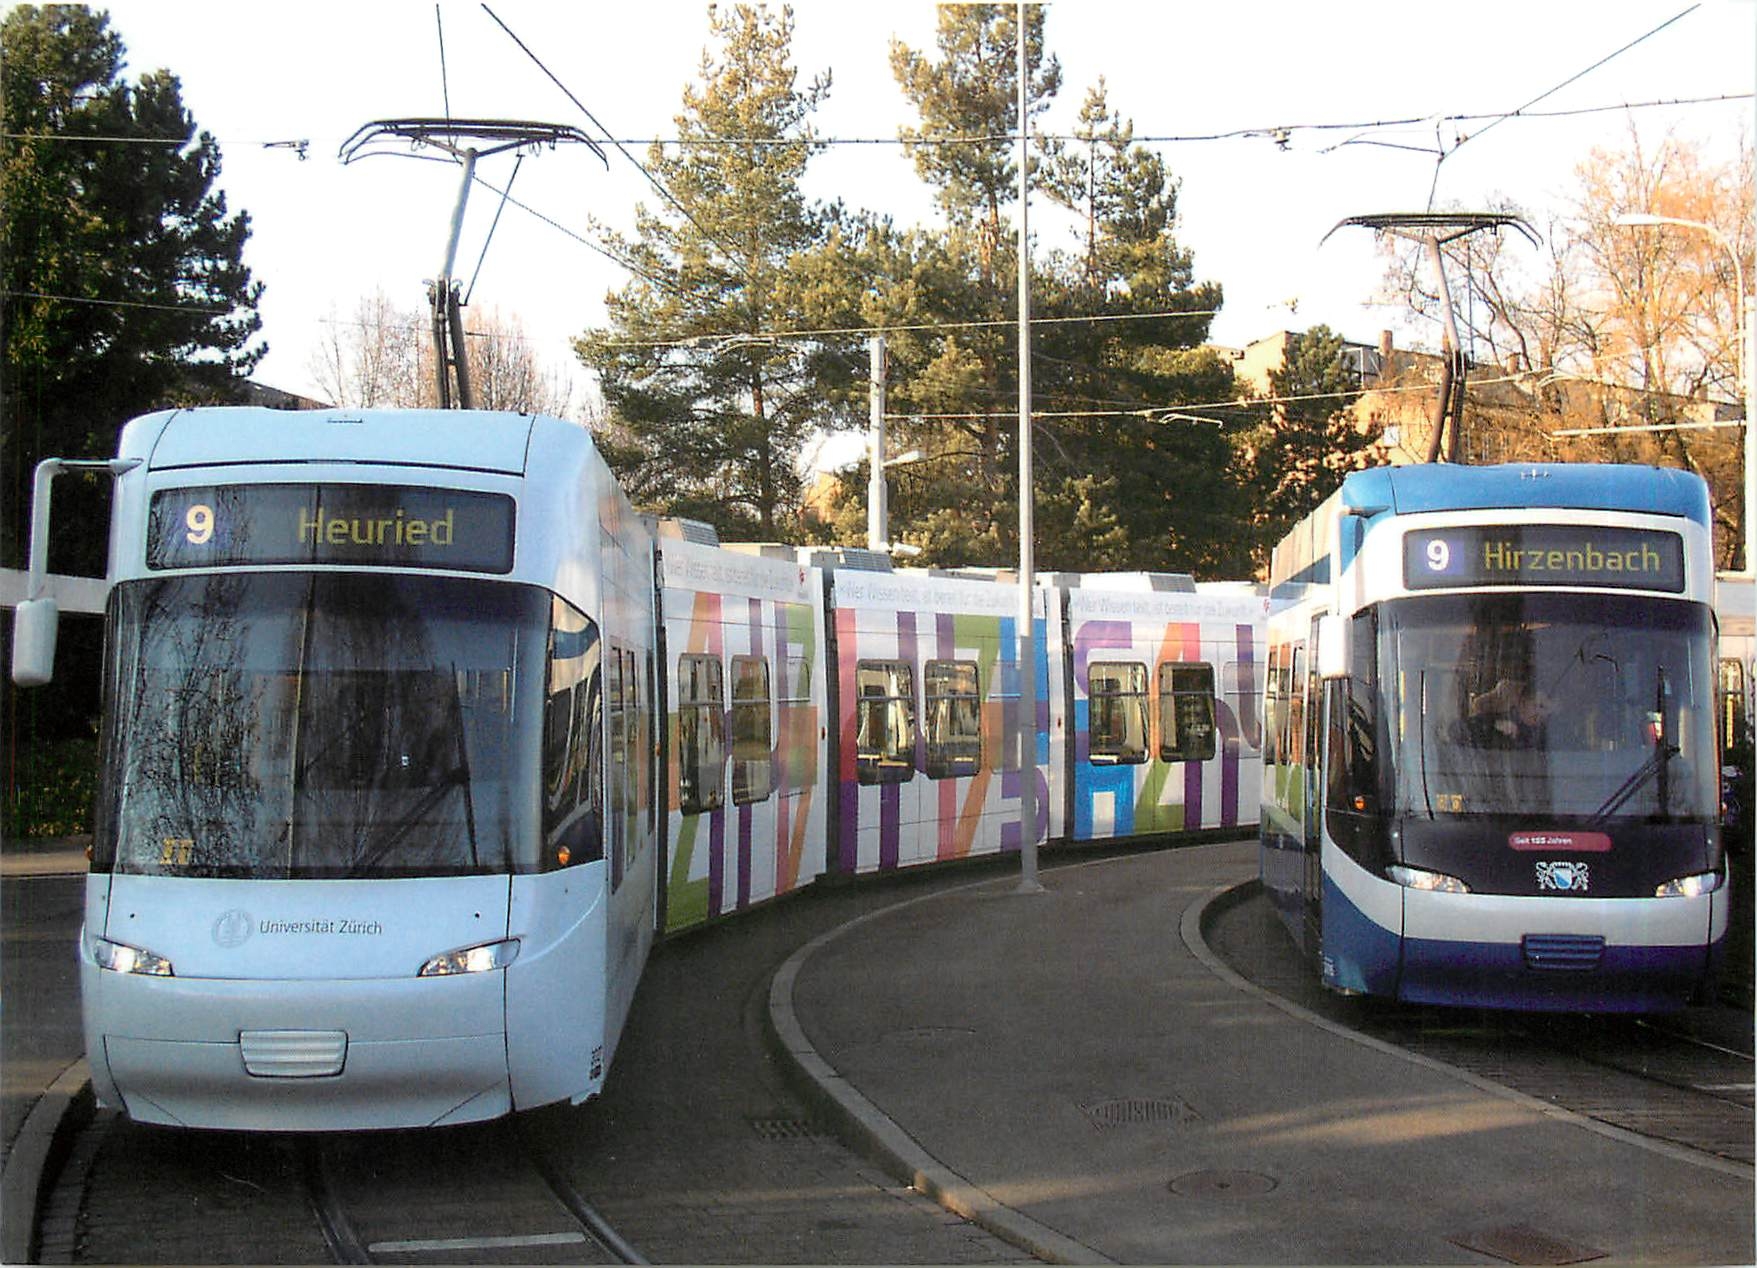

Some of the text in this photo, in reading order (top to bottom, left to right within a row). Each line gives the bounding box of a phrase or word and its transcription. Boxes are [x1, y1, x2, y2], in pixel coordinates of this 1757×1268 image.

[186, 505, 454, 546] 9 Heuried
[1426, 539, 1661, 572] 9 Hirzenbach
[260, 919, 382, 935] Universität Zürich
